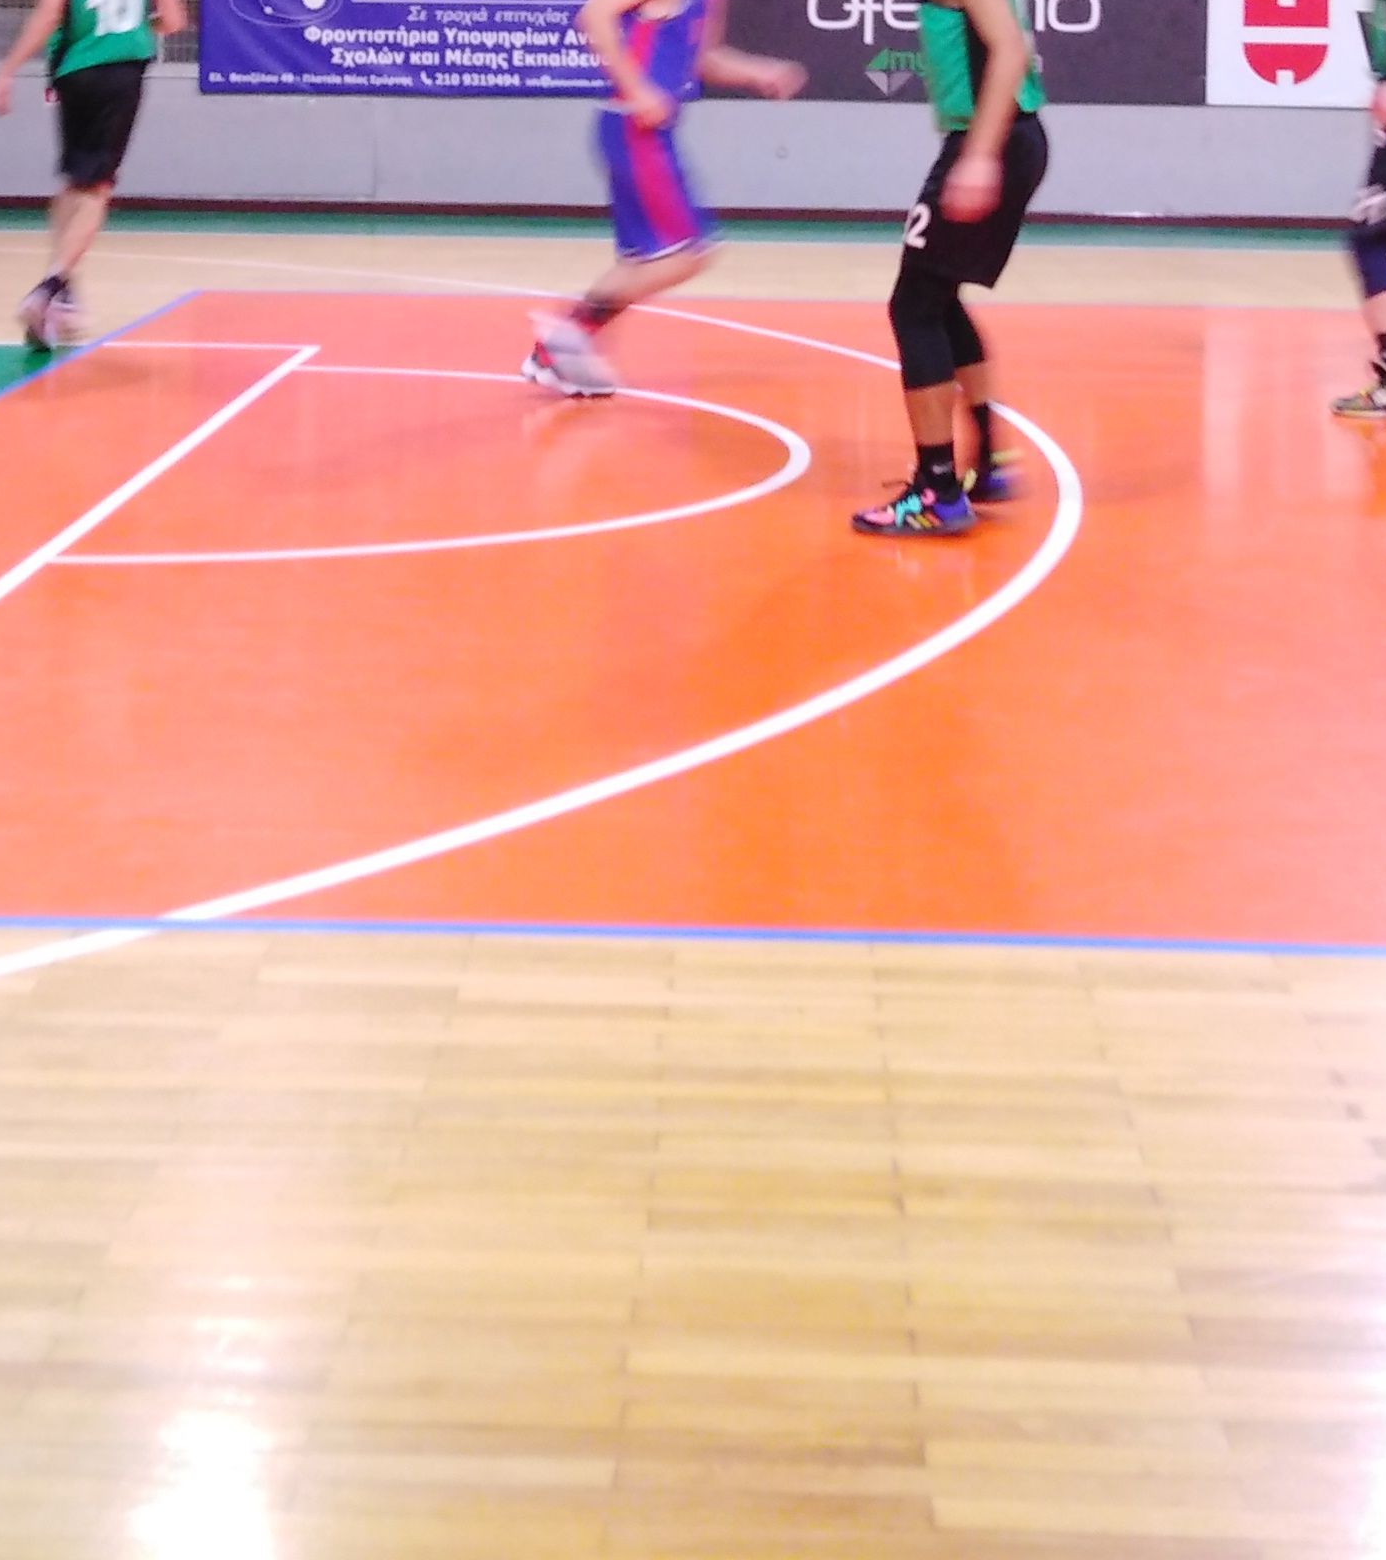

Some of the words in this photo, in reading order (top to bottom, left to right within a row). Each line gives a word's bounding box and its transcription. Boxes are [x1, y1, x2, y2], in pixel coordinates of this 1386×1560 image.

[304, 25, 439, 46] Φροντιστήρια
[444, 26, 560, 47] Υποψηφίων
[331, 46, 404, 66] Σχολών
[409, 48, 439, 64] και
[446, 48, 508, 68] Μέσης
